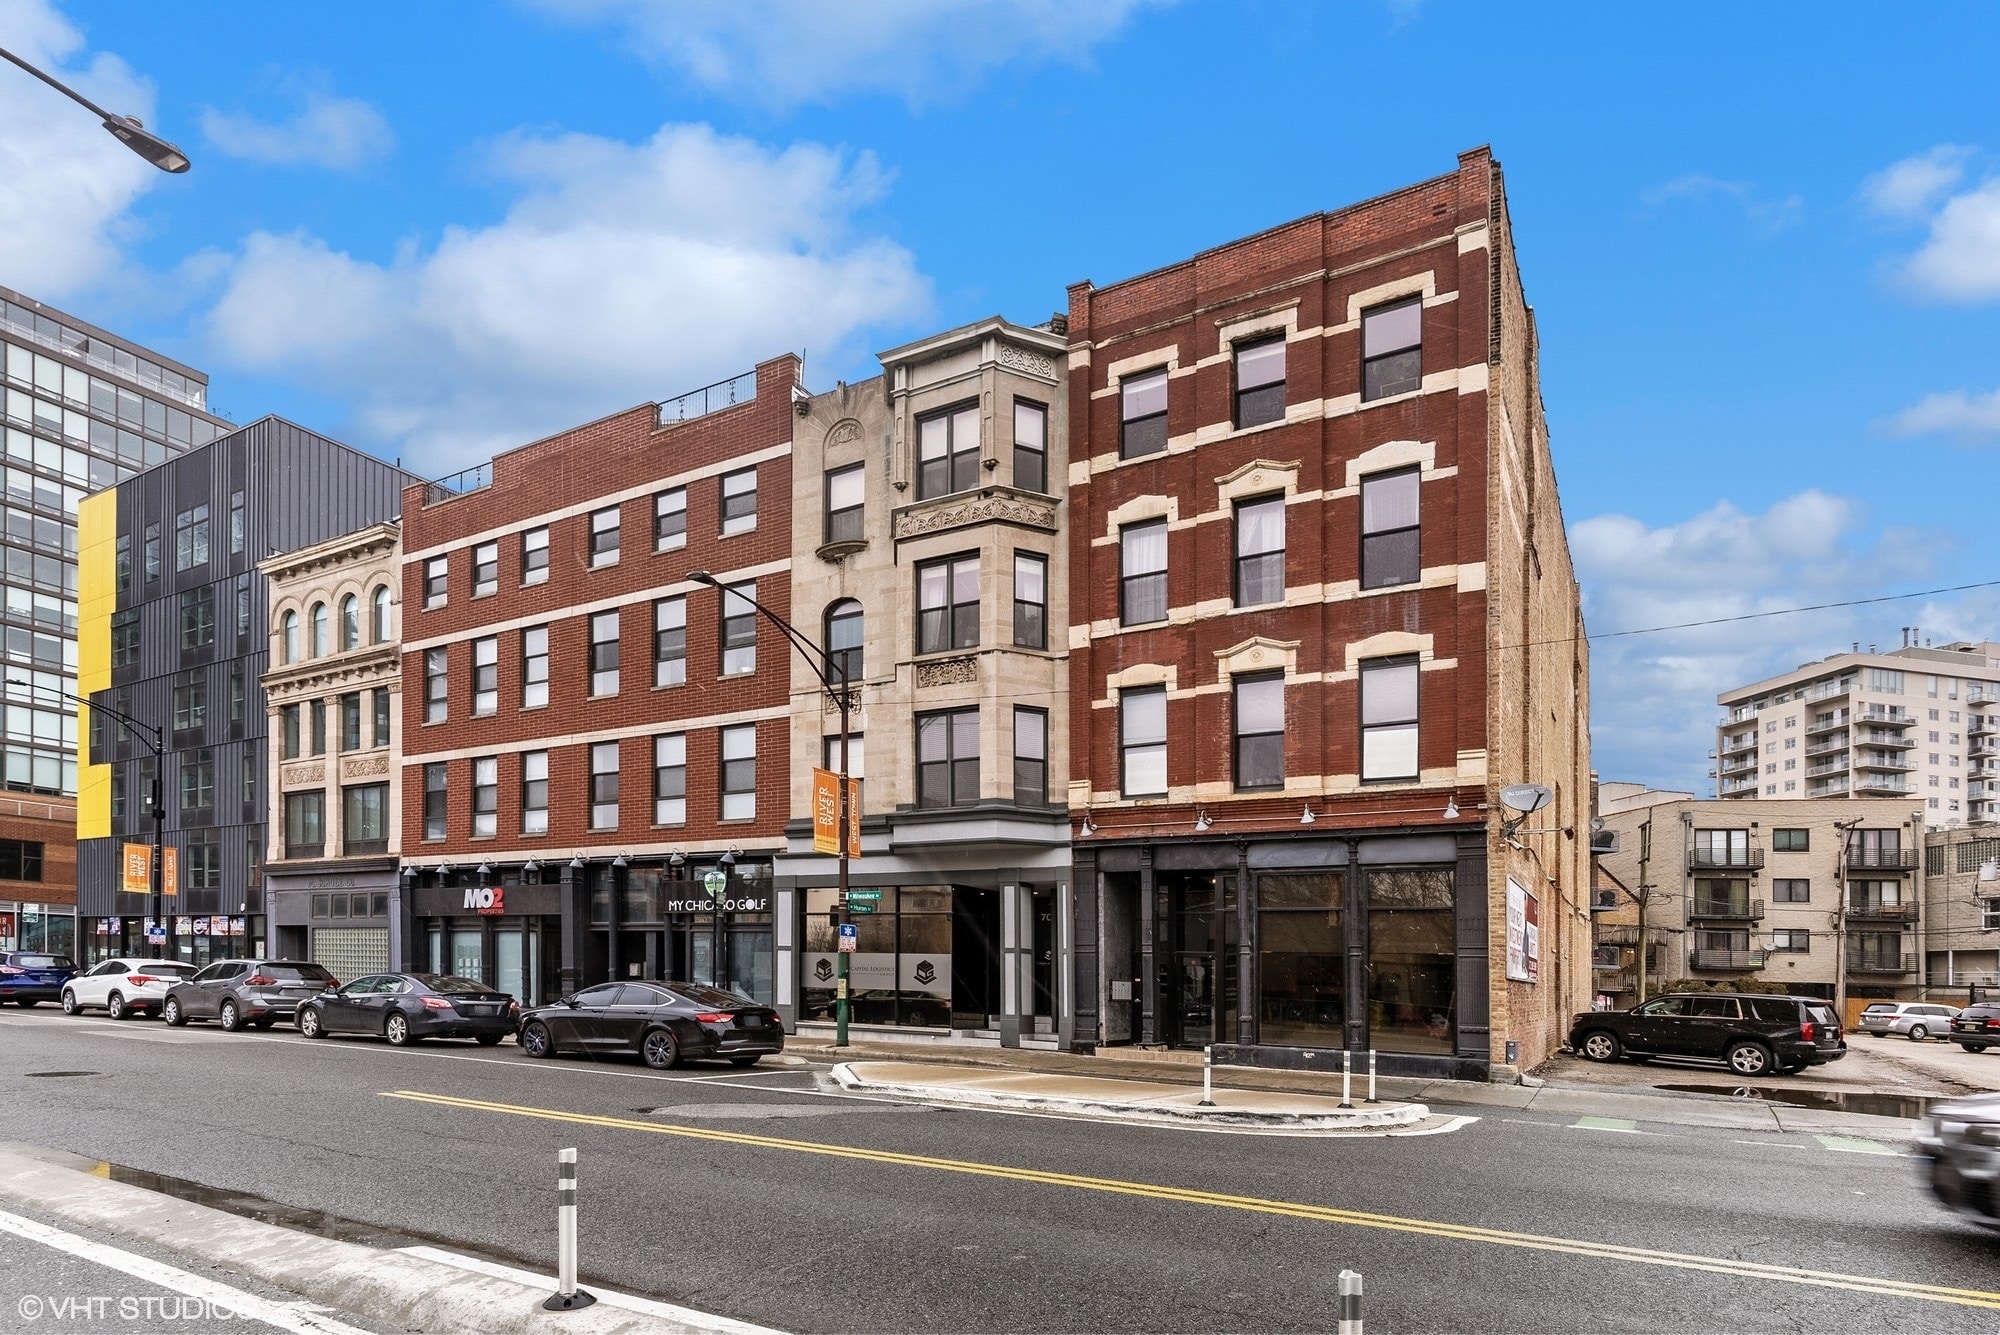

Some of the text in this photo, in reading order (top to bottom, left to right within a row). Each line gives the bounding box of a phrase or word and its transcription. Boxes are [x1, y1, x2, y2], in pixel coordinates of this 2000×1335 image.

[819, 786, 828, 825] RIVER
[826, 793, 834, 826] WEST
[130, 853, 138, 876] RIVER
[137, 855, 146, 877] WEST
[463, 888, 504, 909] MO2
[668, 900, 684, 911] MY
[737, 898, 767, 910] GOLF
